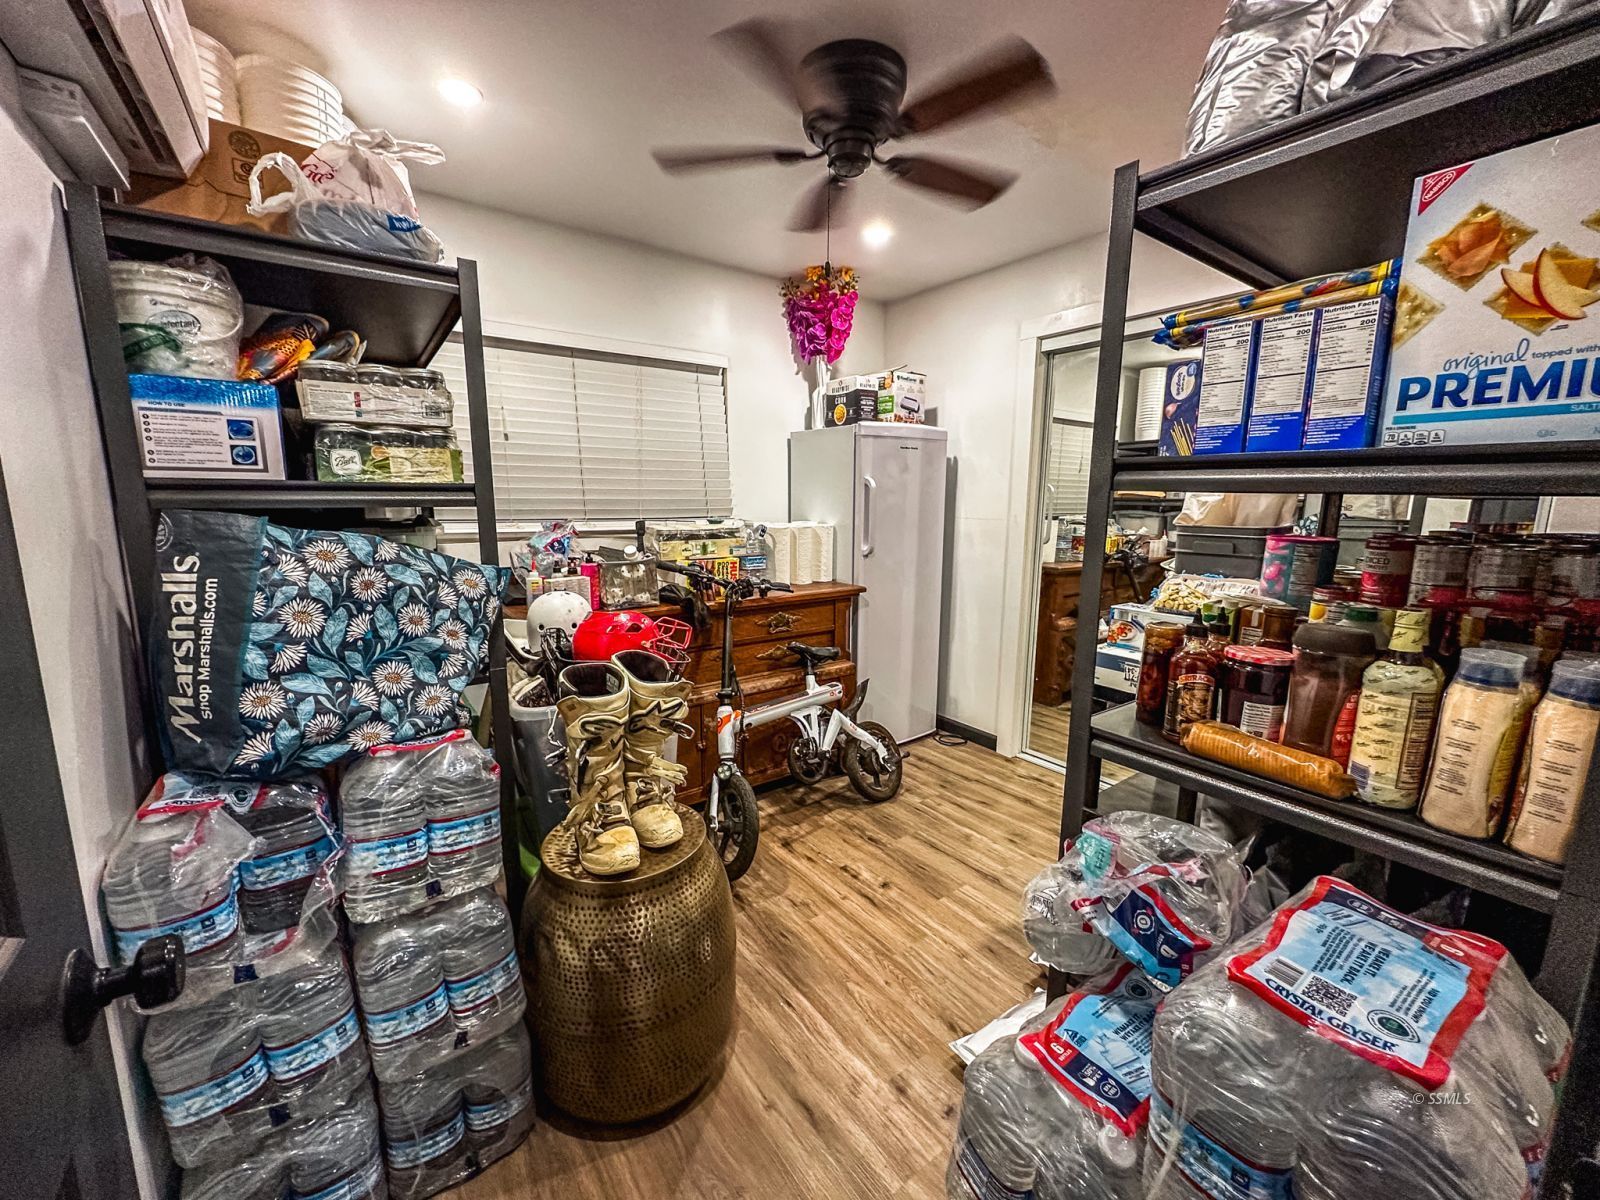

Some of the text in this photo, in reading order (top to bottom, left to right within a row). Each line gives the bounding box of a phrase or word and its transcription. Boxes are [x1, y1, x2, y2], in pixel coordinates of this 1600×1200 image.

[1424, 173, 1453, 199] NABISCO
[1264, 311, 1313, 324] Nutrition Facts
[1324, 299, 1379, 314] Nutrition Facts
[1207, 322, 1251, 334] Nutrition Facts
[1359, 318, 1377, 326] 200
[1443, 338, 1600, 380] original topped with
[1396, 357, 1600, 412] PREMI
[161, 554, 202, 743] Marshalls
[197, 578, 218, 720] shop Marshalls.com
[1265, 978, 1396, 1053] CRYSTAL GEYSER
[1049, 1042, 1065, 1055] 6
